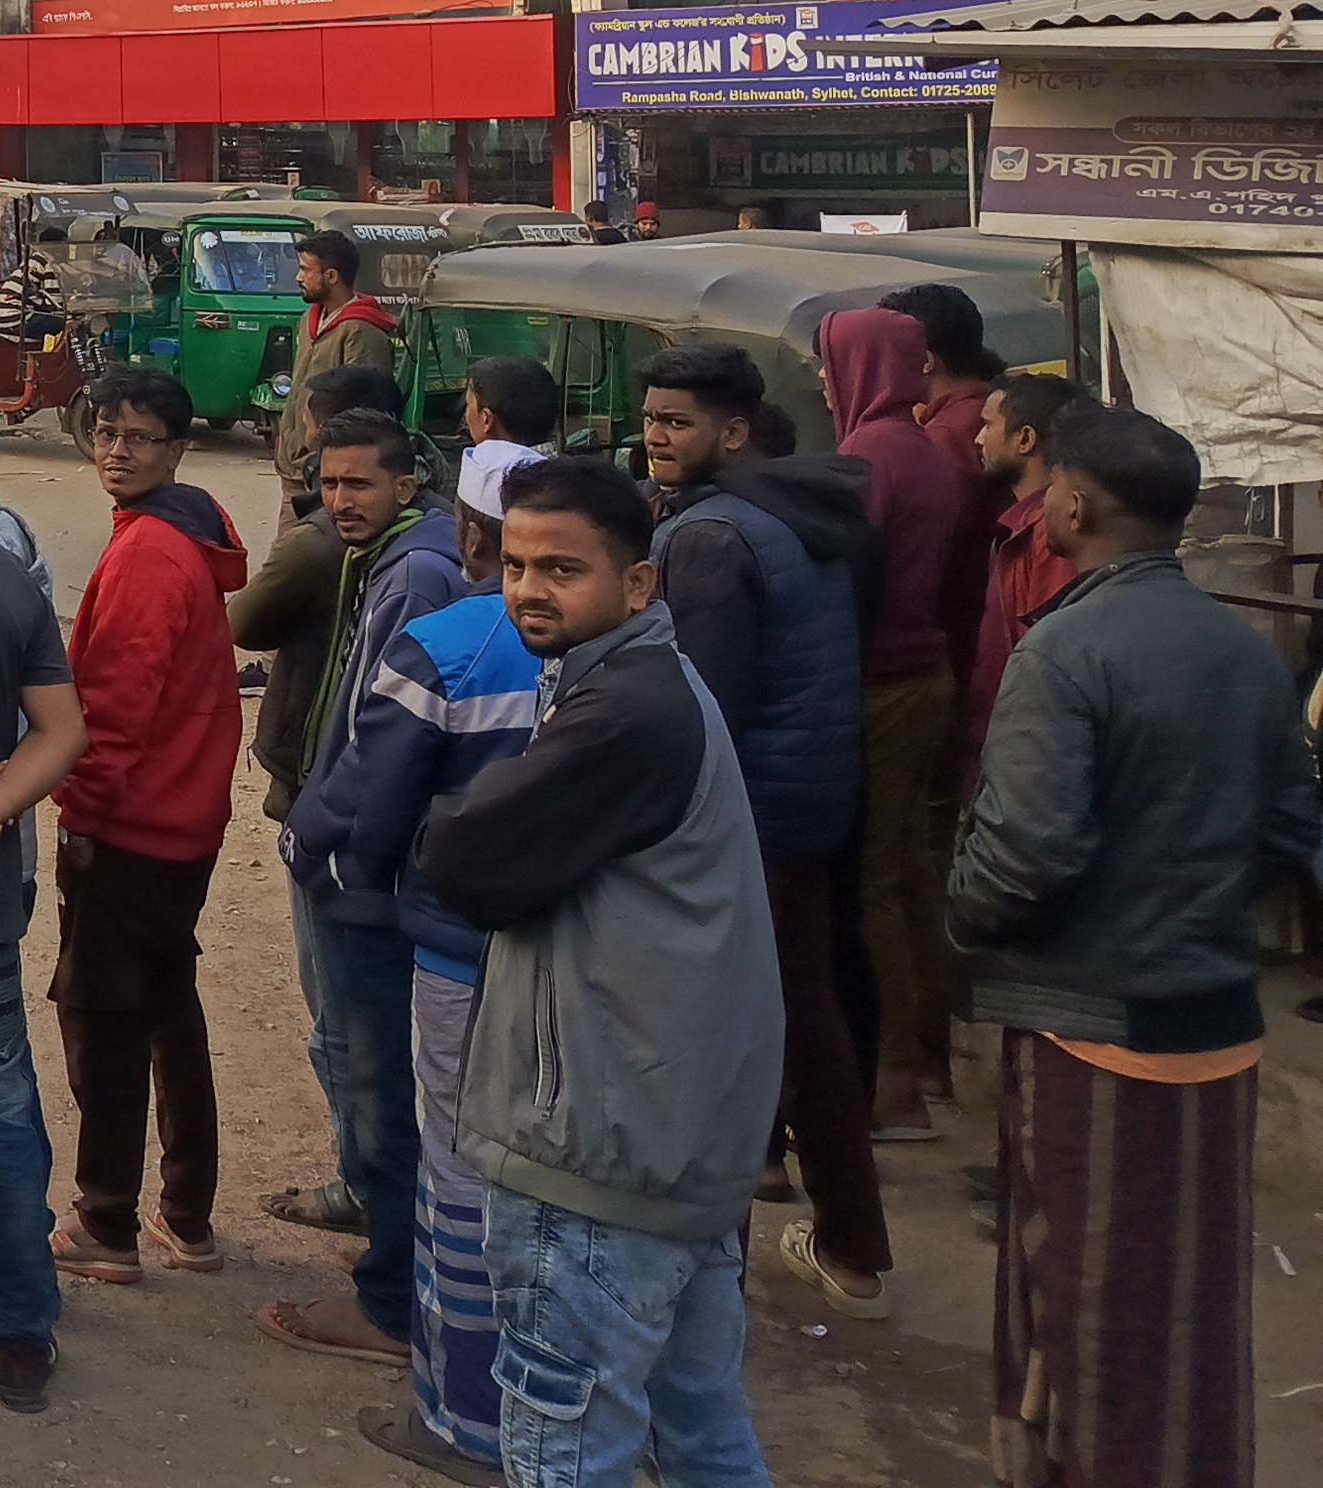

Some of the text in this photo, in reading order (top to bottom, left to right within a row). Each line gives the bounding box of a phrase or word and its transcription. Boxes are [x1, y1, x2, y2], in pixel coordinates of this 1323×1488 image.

[588, 40, 721, 76] CAMBRIAN
[845, 71, 890, 82] British
[895, 71, 905, 80] &
[909, 69, 967, 80] National
[622, 90, 687, 105] Rampasha
[690, 90, 727, 103] Road,
[729, 87, 809, 102] Bishwanath,
[812, 87, 857, 100] Sylhet,
[861, 86, 918, 98] Contact:
[759, 150, 887, 175] CAMBRIAN
[1035, 146, 1323, 184] সন্ধানী ডিজি
